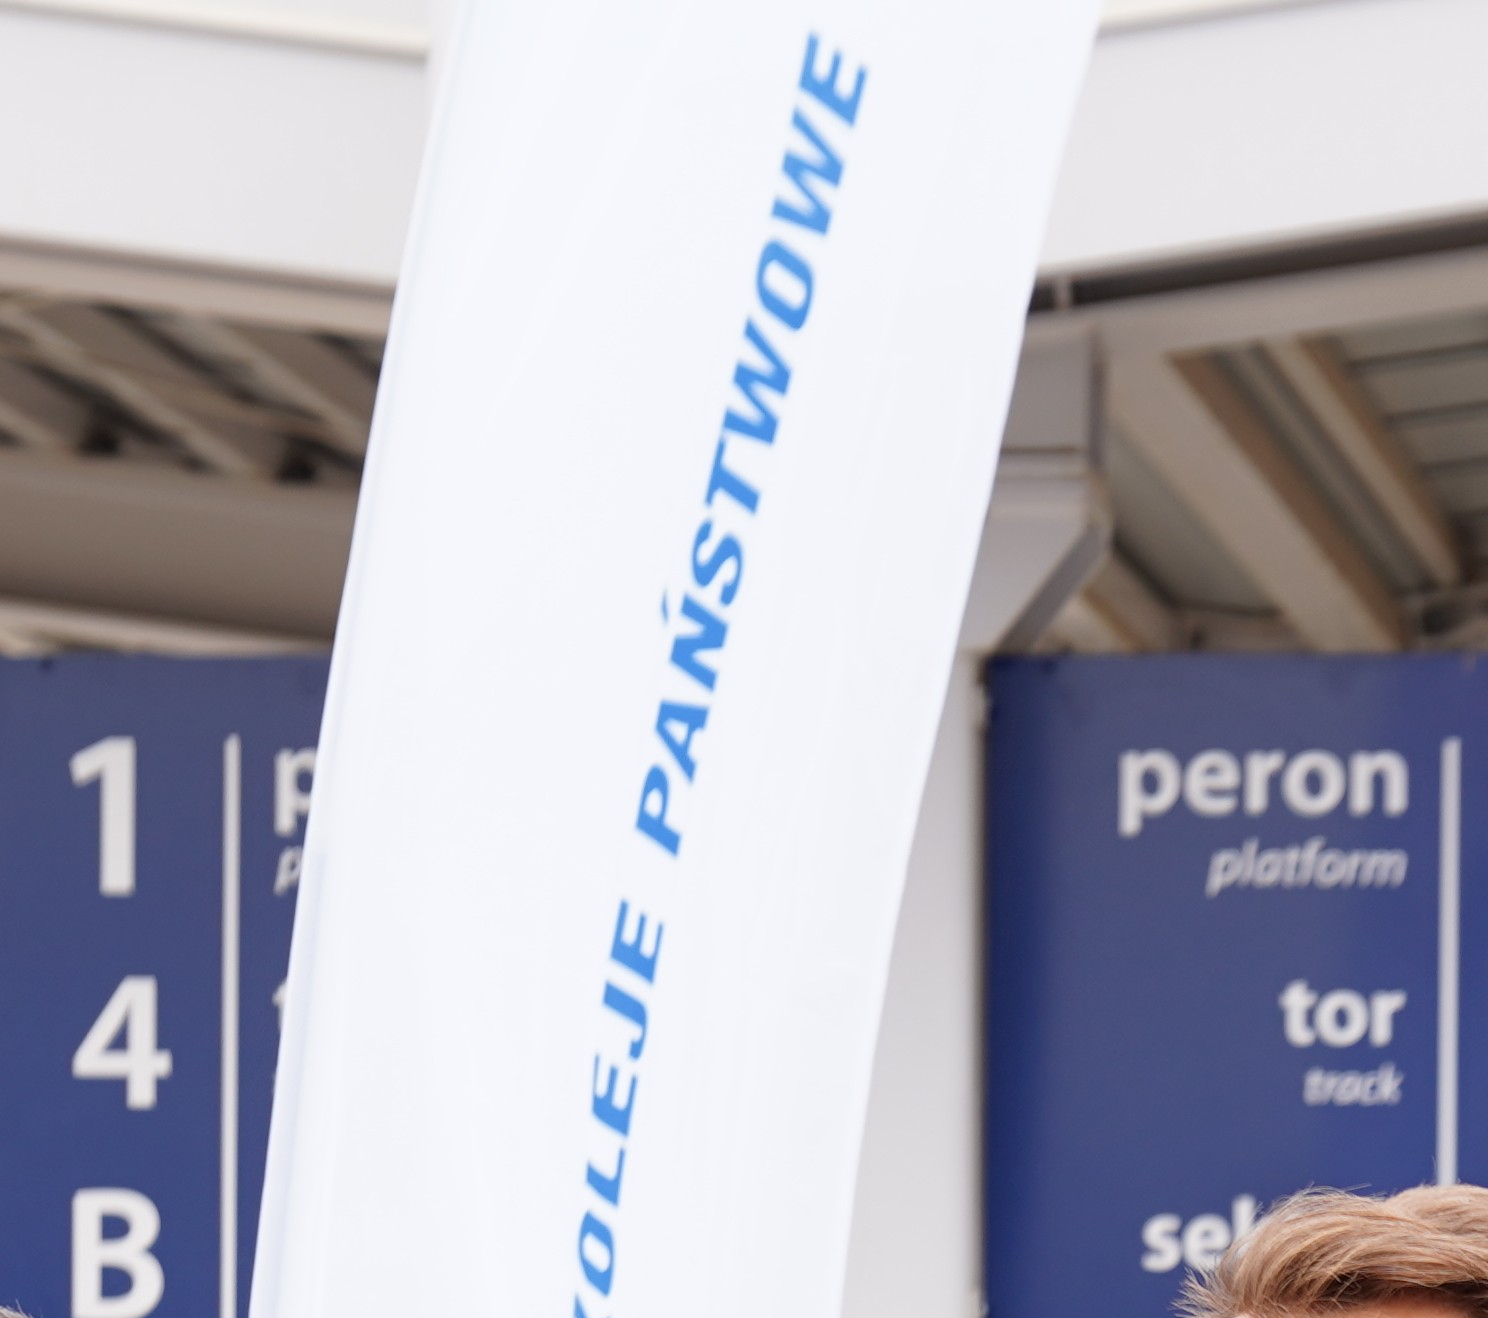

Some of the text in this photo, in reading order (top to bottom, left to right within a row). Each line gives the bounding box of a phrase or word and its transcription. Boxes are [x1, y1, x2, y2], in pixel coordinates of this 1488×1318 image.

[633, 30, 869, 860] PAŃSTWOWE
[69, 736, 136, 896] 1
[1117, 748, 1409, 836] peron
[1205, 838, 1408, 898] platform
[72, 975, 172, 1110] 4
[1279, 980, 1406, 1047] tor
[1303, 1064, 1403, 1106] track
